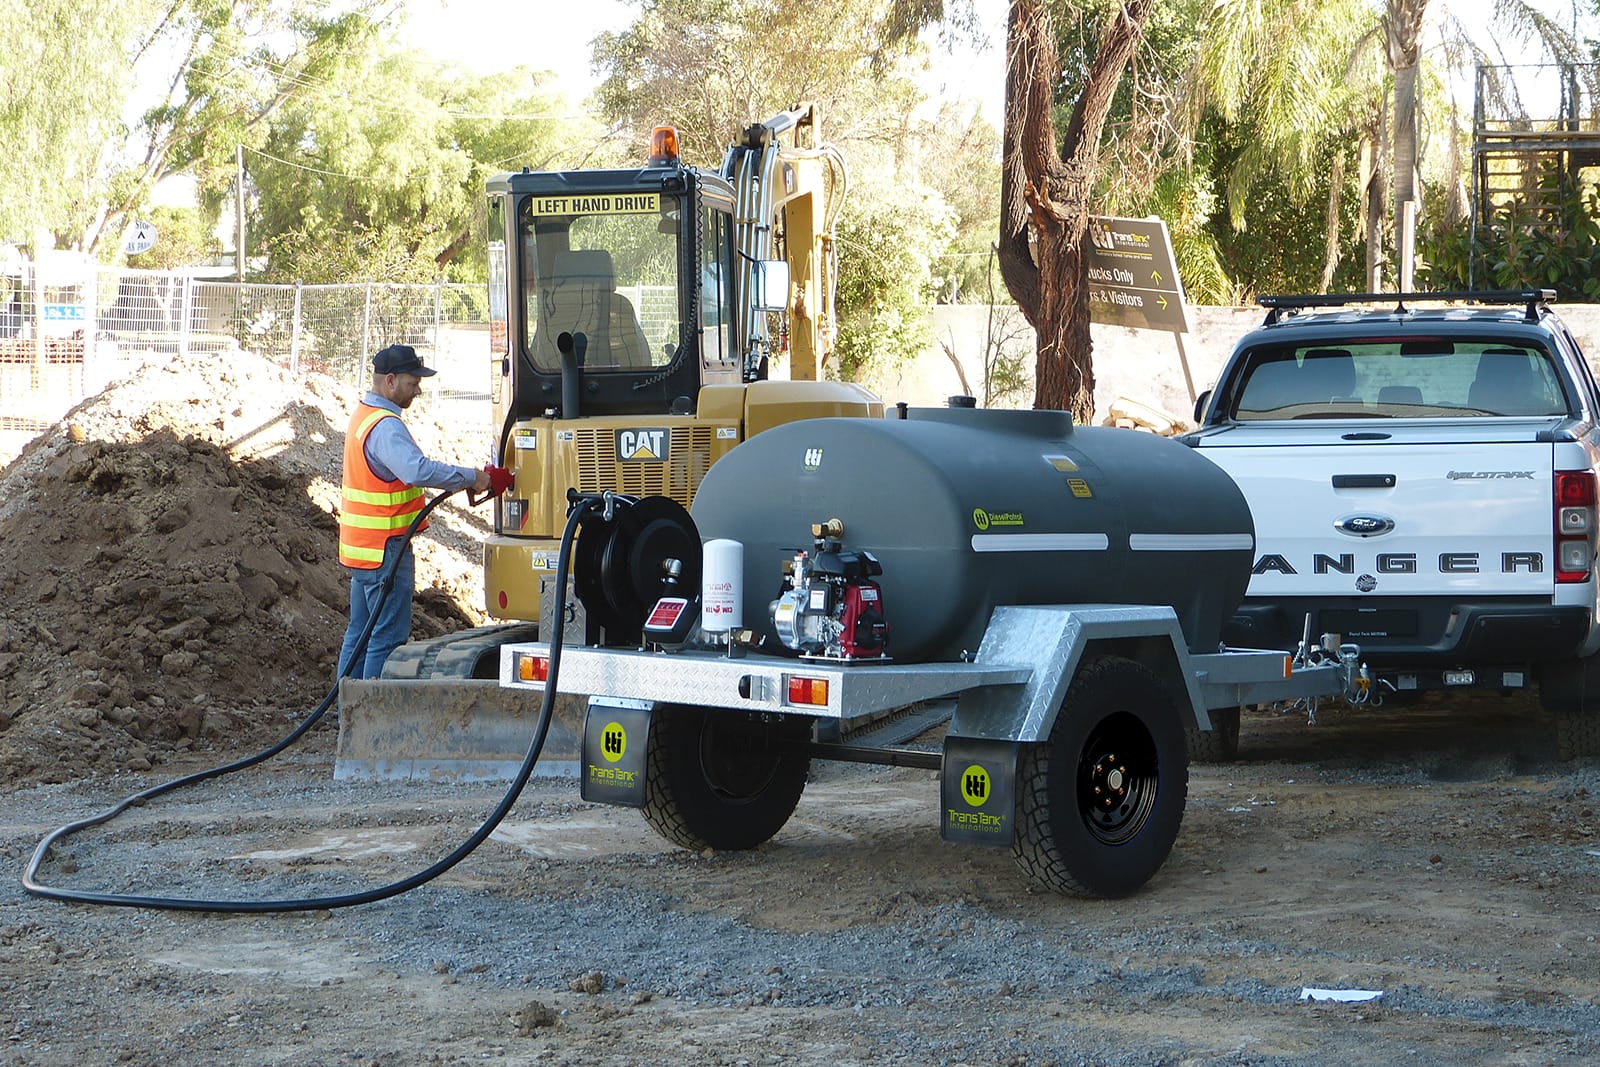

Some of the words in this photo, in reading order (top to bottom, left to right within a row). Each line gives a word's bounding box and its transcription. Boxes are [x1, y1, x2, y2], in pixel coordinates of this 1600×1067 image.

[537, 199, 569, 213] LEFT
[572, 197, 611, 212] HAND
[614, 196, 655, 211] DRIVE
[1088, 267, 1113, 282] rucks
[1113, 267, 1134, 286] Only
[1100, 289, 1109, 303] &
[1108, 290, 1144, 308] Visitors
[620, 431, 664, 459] CAT
[1351, 517, 1378, 531] Ford
[1251, 552, 1544, 575] ANGER
[605, 731, 623, 754] tti
[590, 775, 635, 789] International
[965, 774, 986, 798] tti
[950, 821, 1002, 833] International
